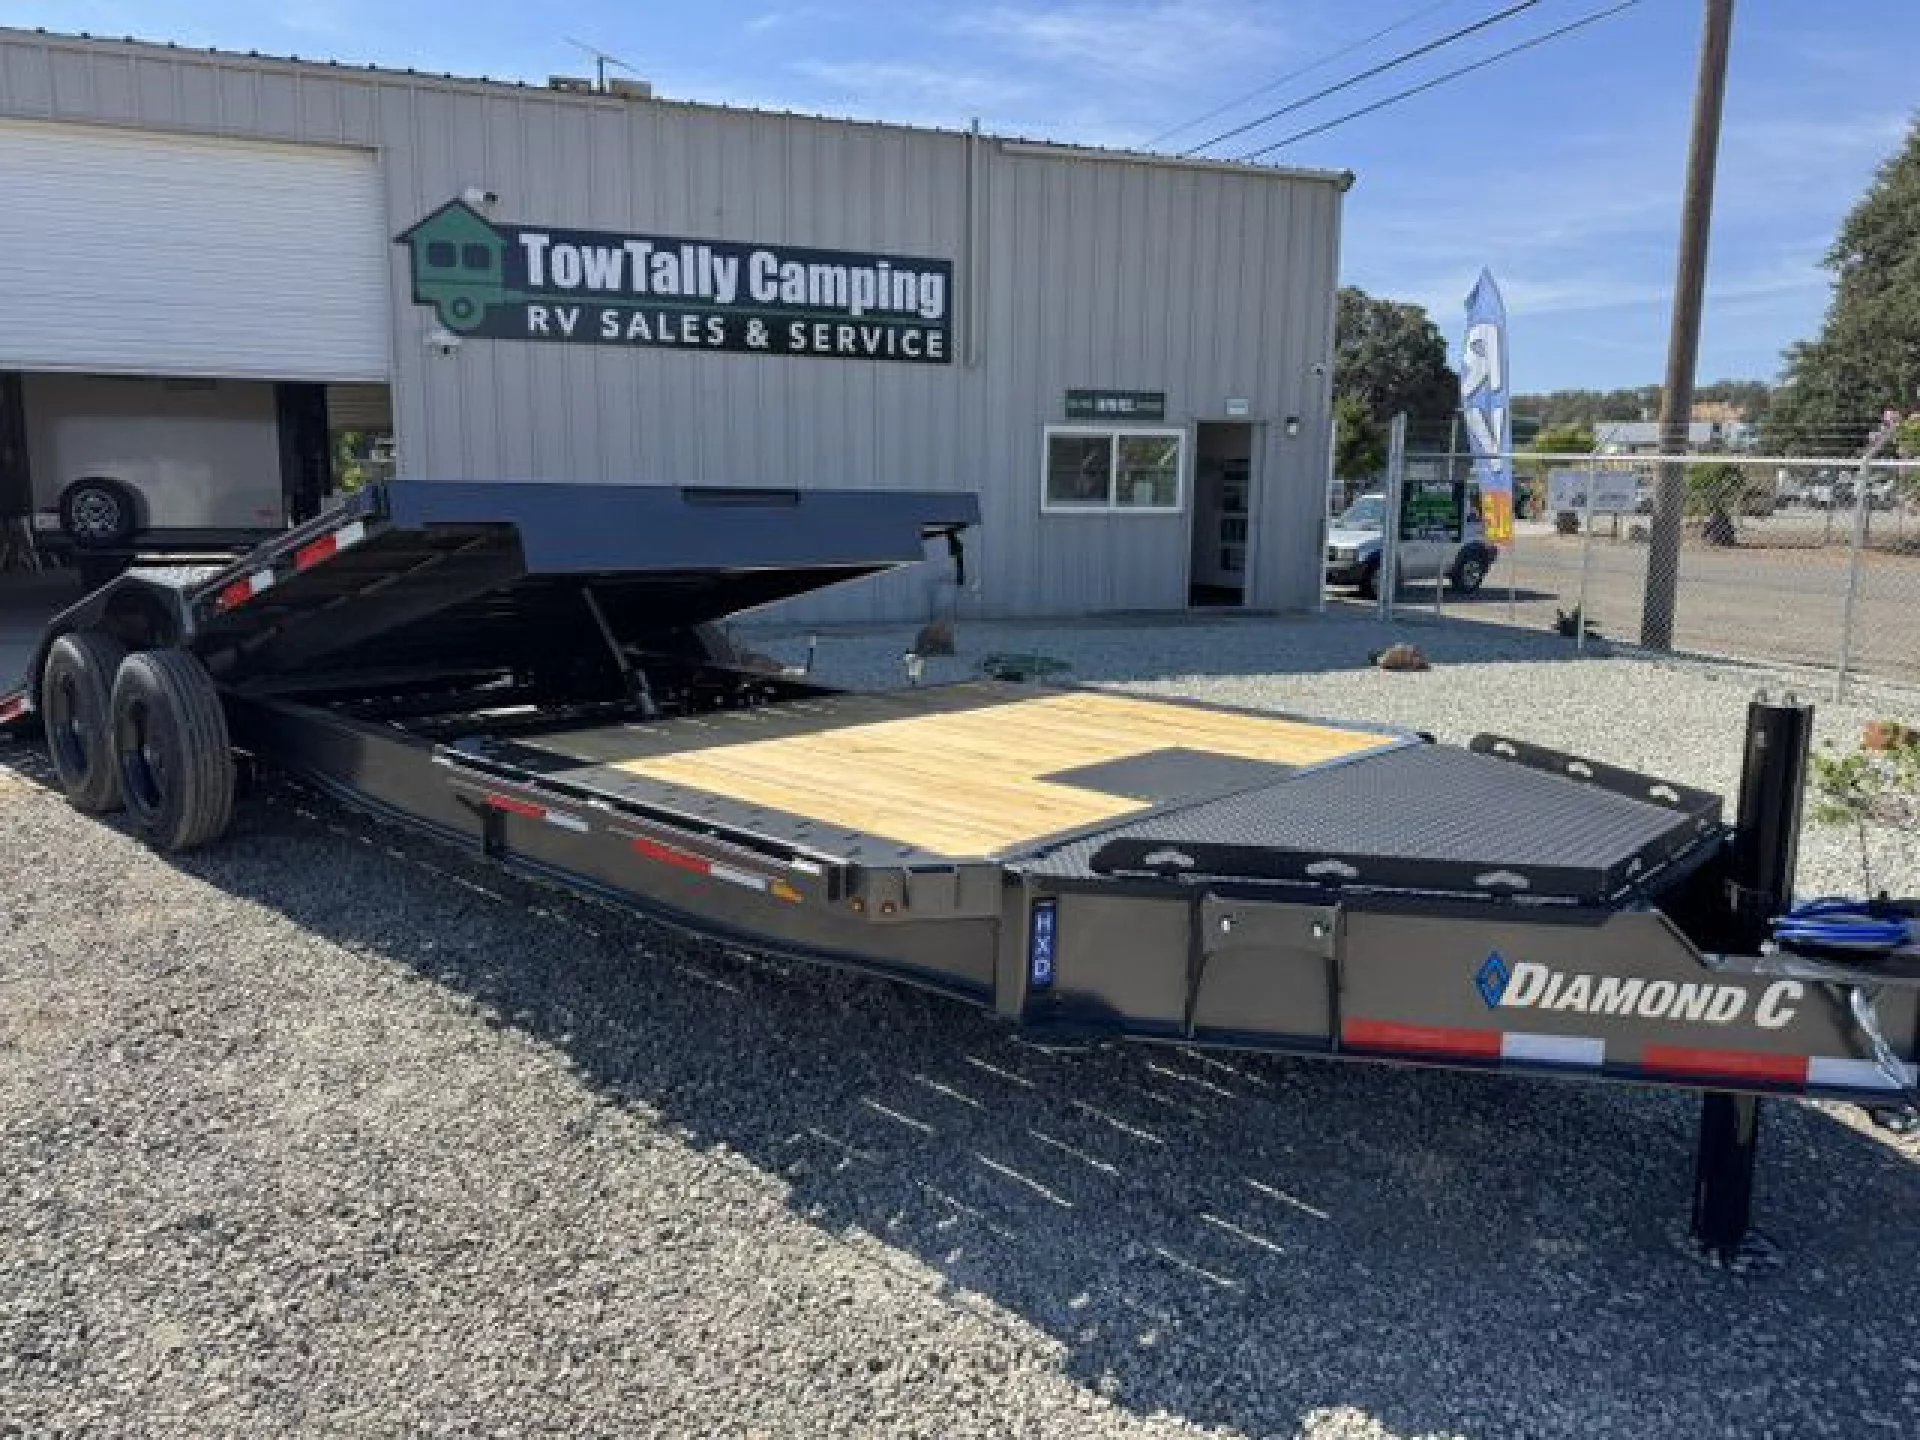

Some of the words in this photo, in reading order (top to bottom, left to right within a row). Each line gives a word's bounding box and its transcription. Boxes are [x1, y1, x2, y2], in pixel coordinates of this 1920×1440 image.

[519, 233, 738, 303] TowTally
[750, 250, 945, 319] Camping
[527, 305, 580, 337] RV
[600, 308, 725, 345] SALES
[744, 317, 770, 349] &
[788, 320, 944, 358] SERVICE
[1034, 911, 1053, 979] HXD
[1500, 962, 1749, 1023] DIAMOND
[1754, 980, 1805, 1030] C
